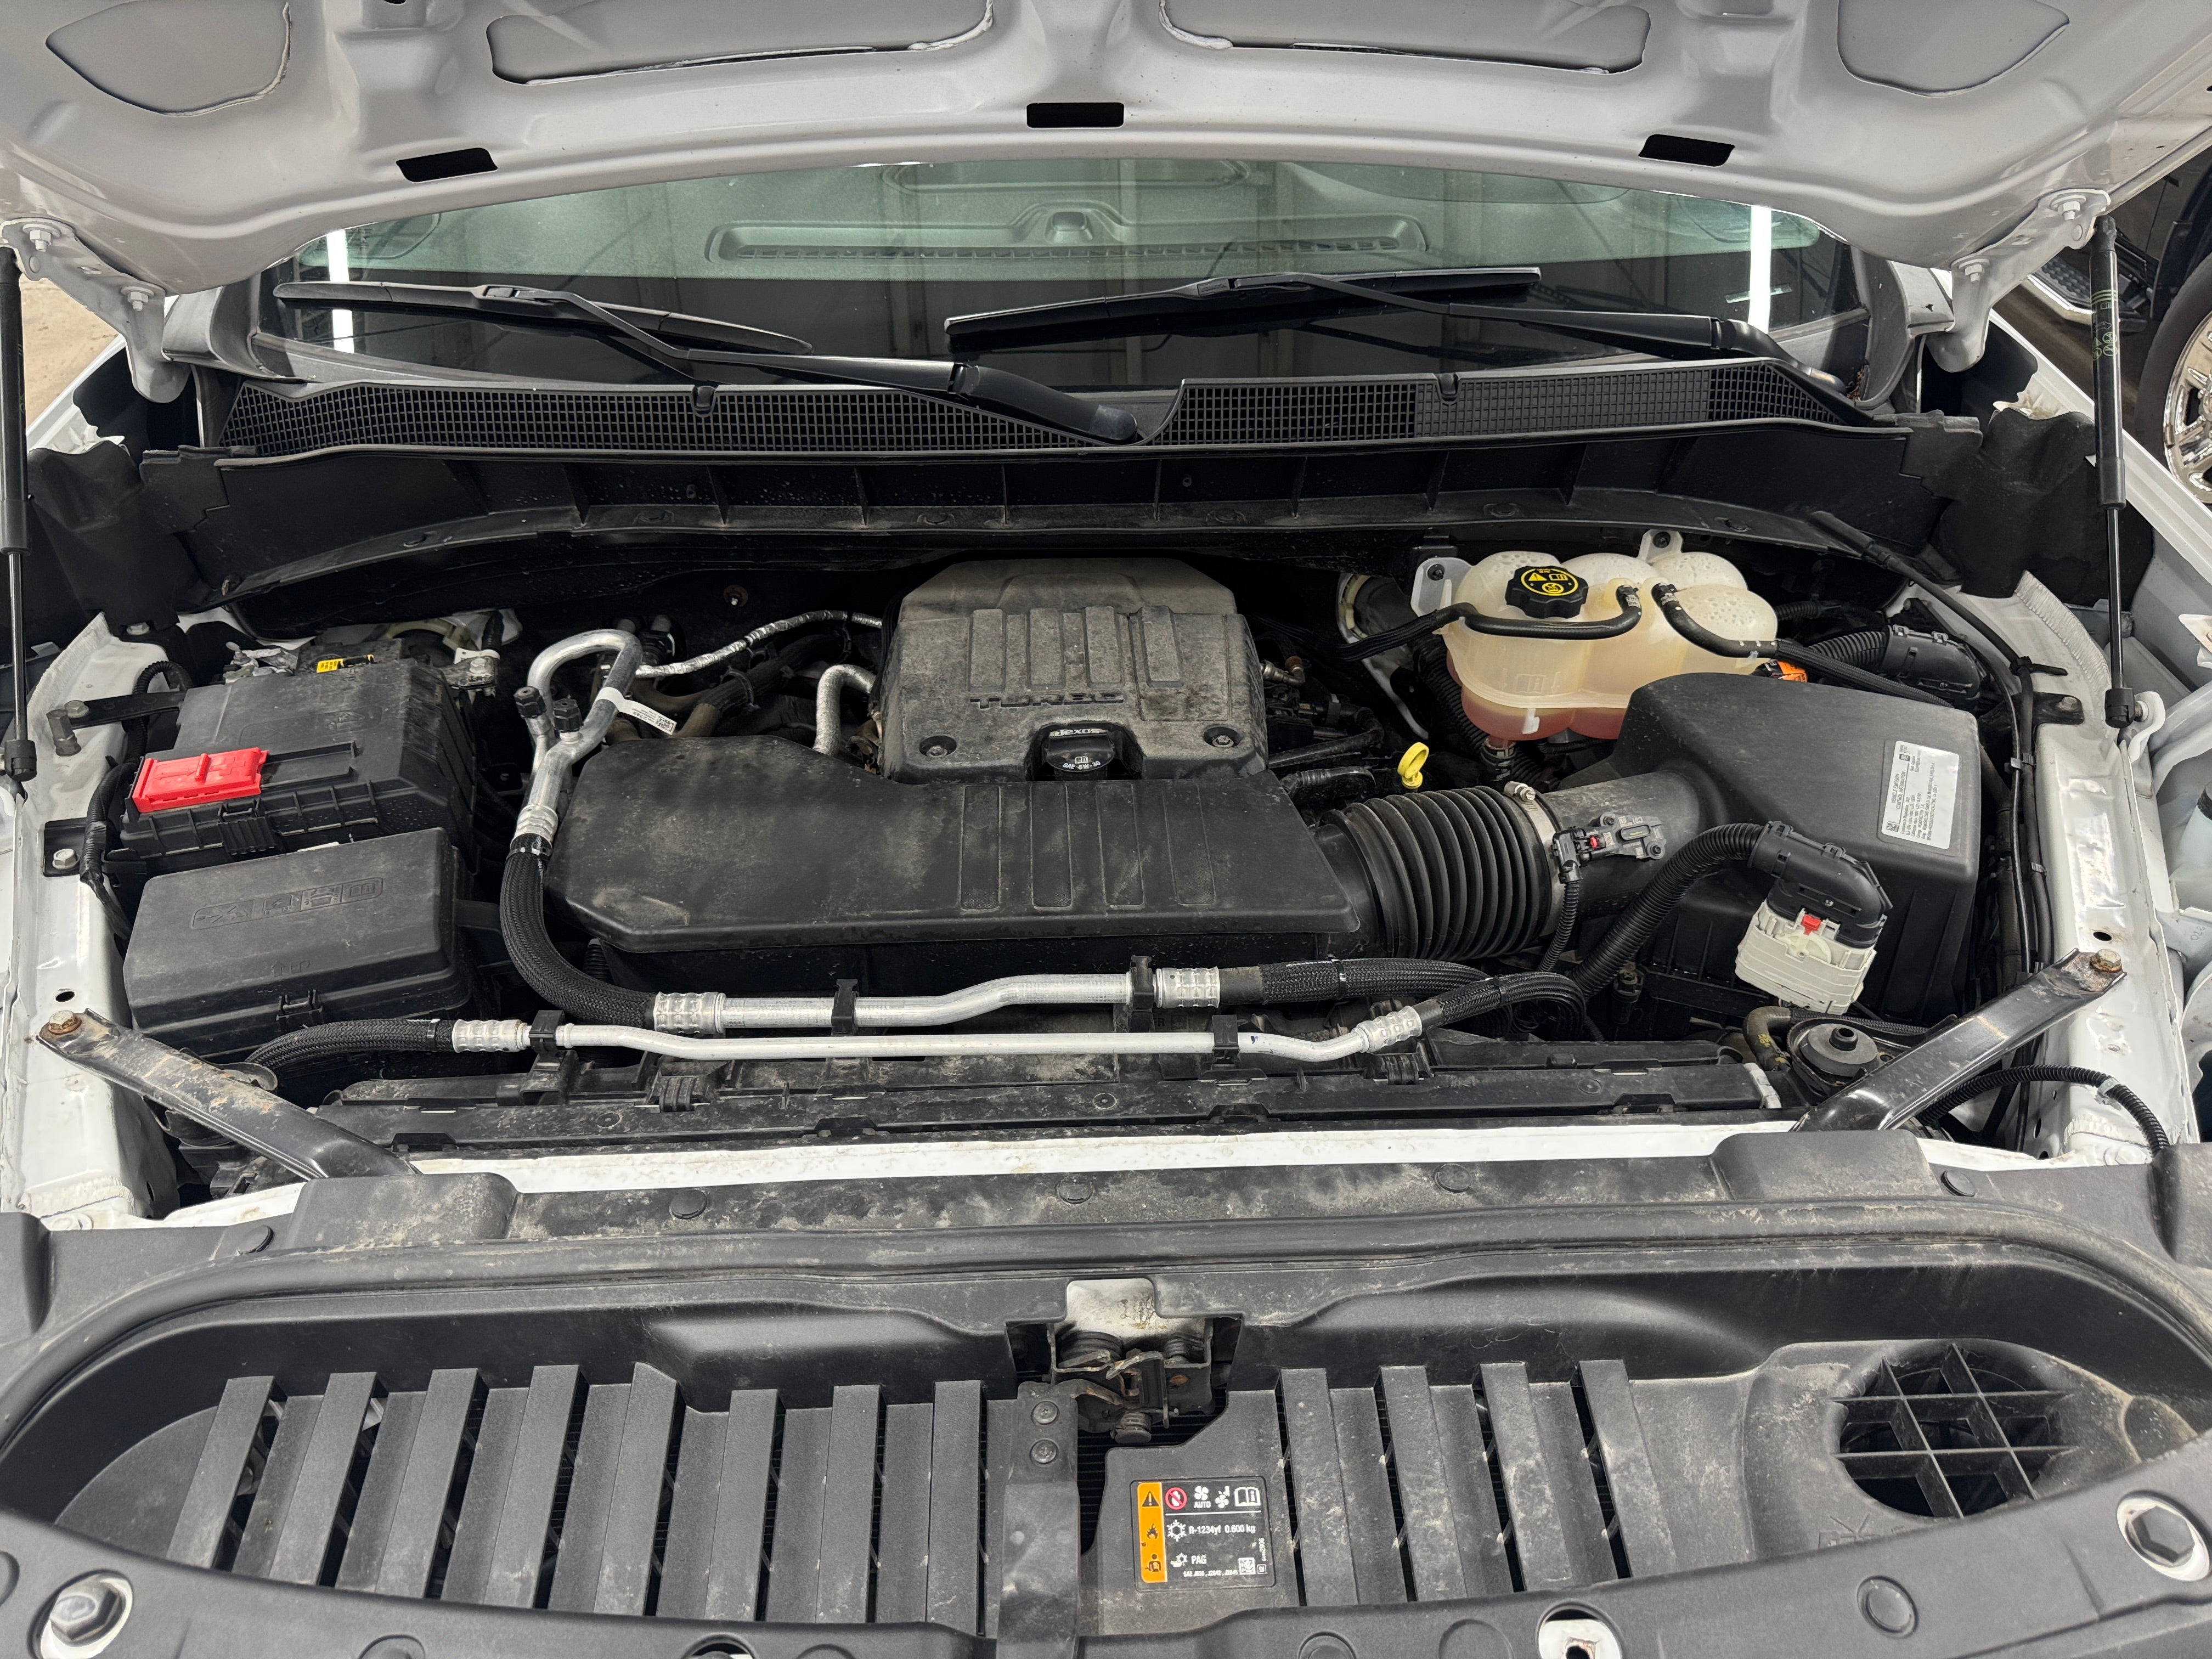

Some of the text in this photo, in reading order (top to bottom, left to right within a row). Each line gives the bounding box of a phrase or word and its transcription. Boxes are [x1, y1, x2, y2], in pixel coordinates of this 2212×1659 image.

[1189, 1524, 1256, 1535] R-1234yf 0.600 kg
[1191, 1555, 1207, 1564] PAG
